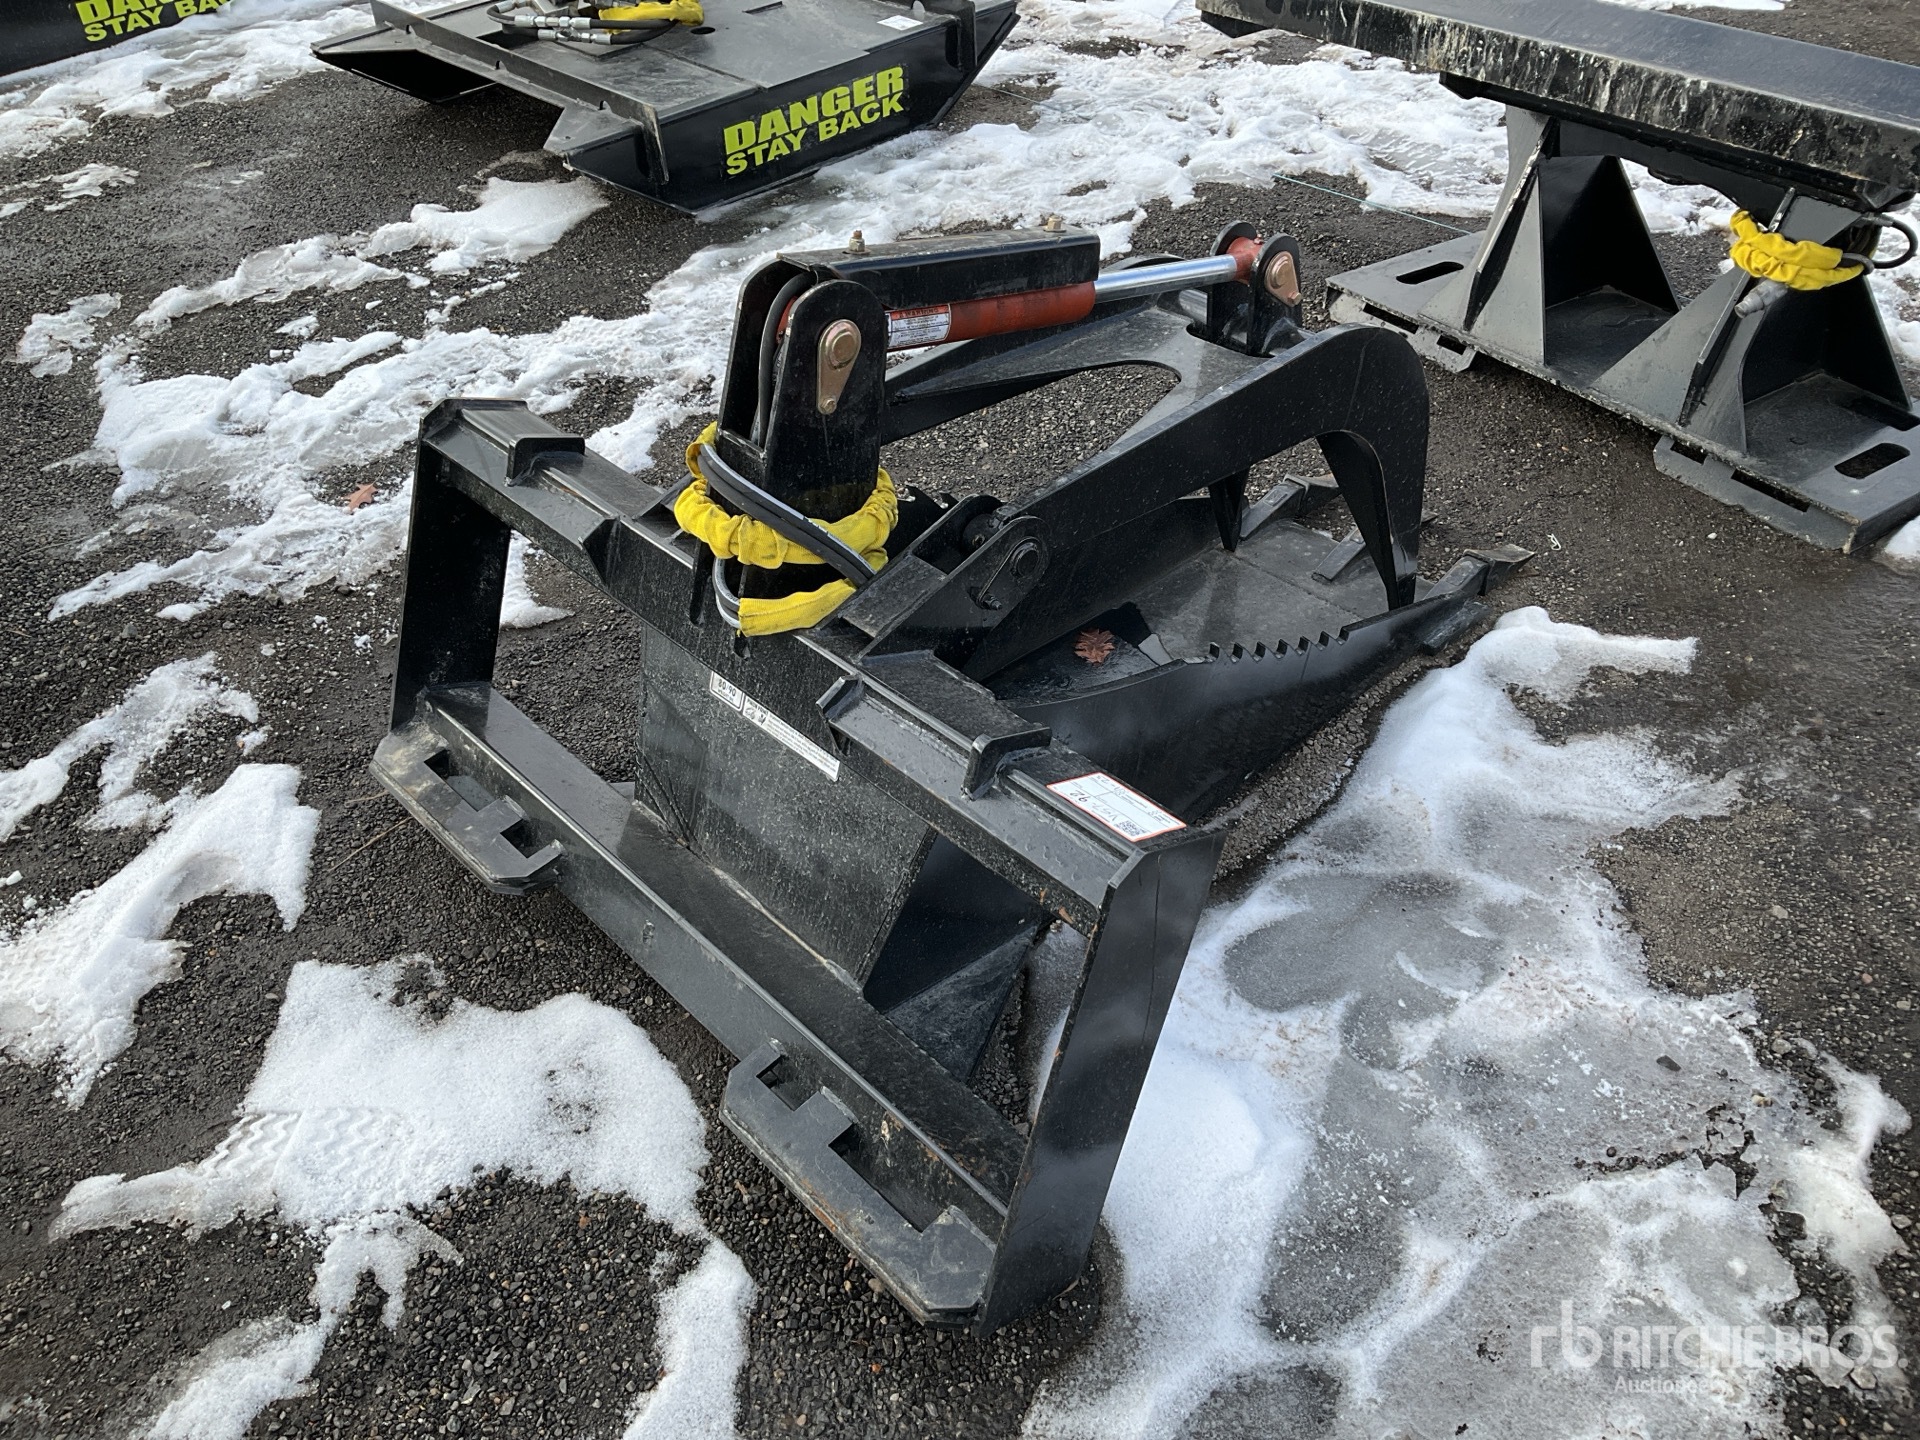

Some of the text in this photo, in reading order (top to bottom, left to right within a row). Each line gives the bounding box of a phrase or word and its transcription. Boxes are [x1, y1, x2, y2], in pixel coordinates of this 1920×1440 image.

[84, 6, 164, 42] STAY
[723, 66, 904, 155] DANGER
[726, 92, 904, 175] STAY BACK
